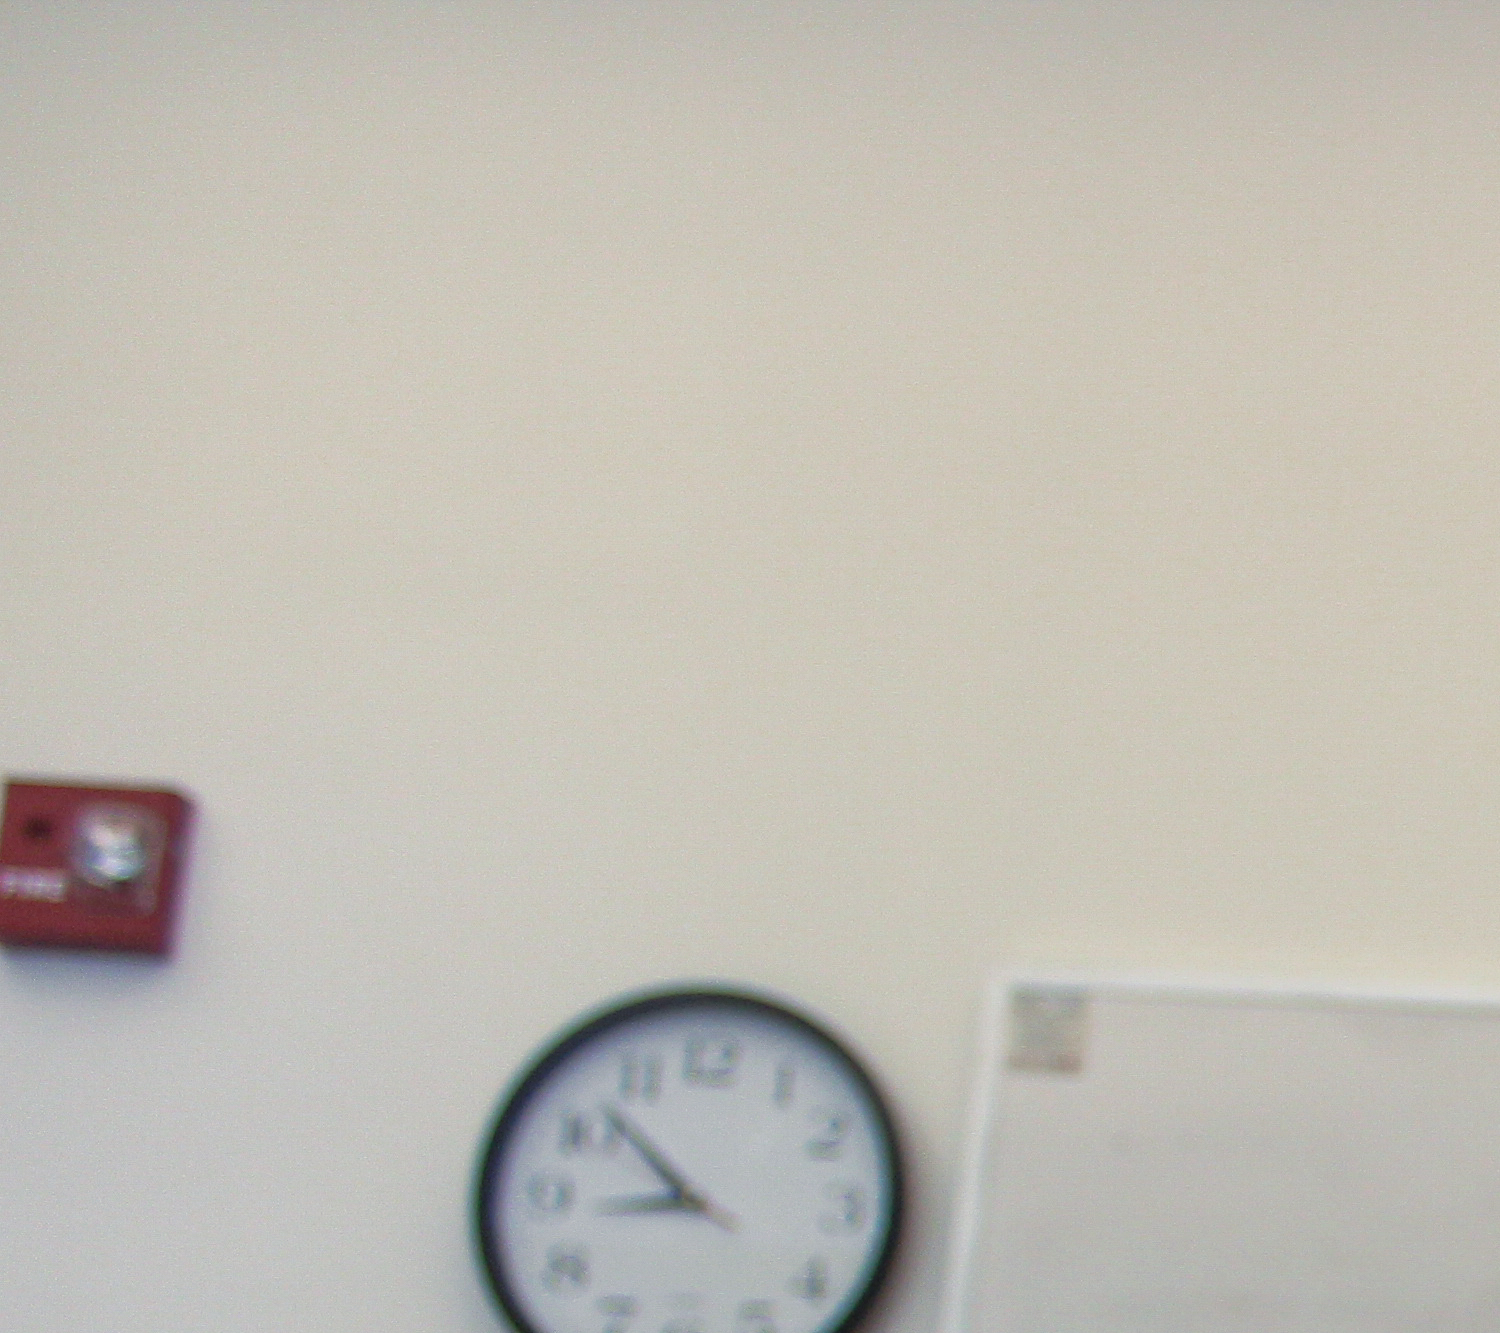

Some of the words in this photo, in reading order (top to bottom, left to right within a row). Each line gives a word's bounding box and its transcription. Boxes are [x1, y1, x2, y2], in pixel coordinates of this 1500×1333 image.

[617, 1050, 662, 1106] 11
[682, 1030, 740, 1090] 12
[772, 1057, 798, 1112] 1
[803, 1105, 852, 1162] 2
[526, 1168, 577, 1223] 9
[816, 1178, 867, 1237] 3
[540, 1241, 592, 1298] 8
[786, 1254, 831, 1309] 4
